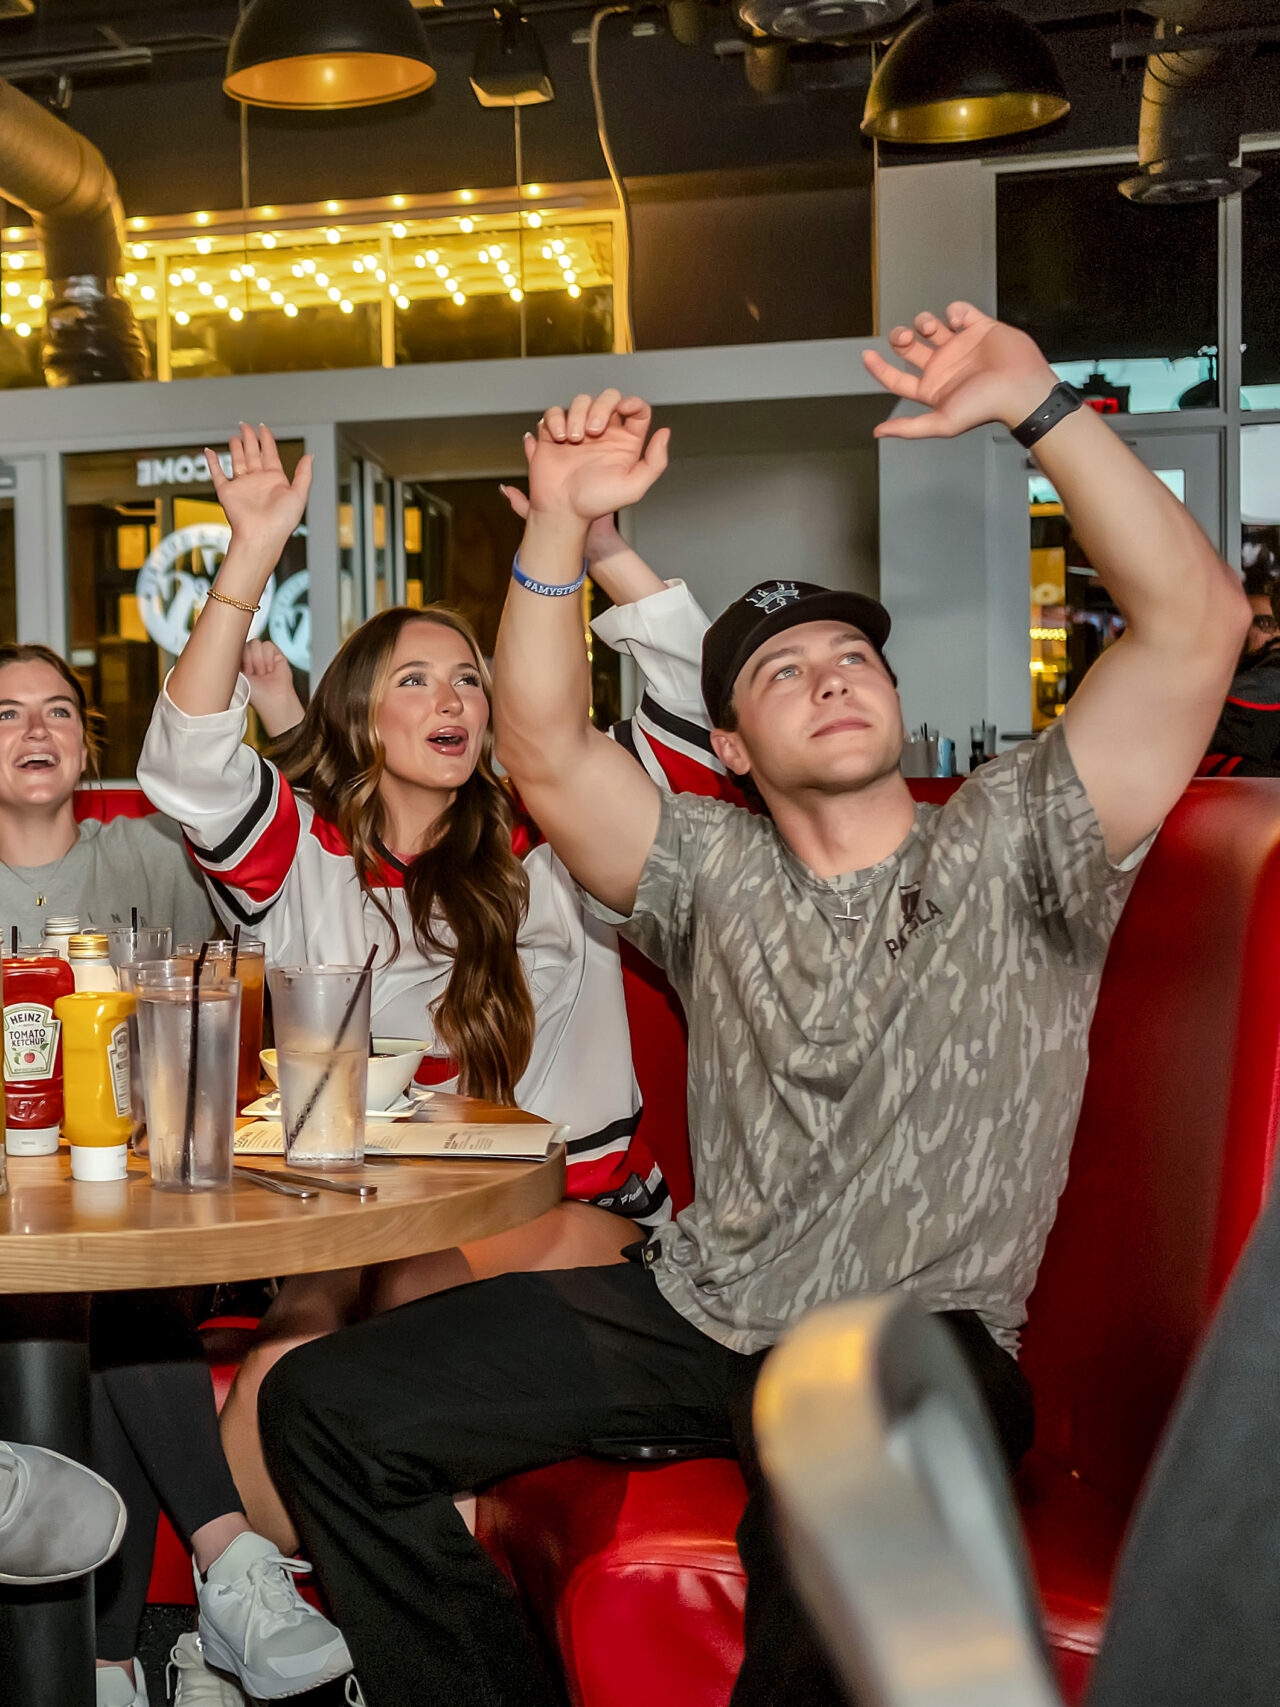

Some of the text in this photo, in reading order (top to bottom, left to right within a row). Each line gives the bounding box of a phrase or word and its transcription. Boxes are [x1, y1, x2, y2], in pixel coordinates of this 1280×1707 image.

[10, 1012, 42, 1025] HEINZ
[9, 1028, 46, 1040] TOMATO
[11, 1037, 46, 1047] KETCHUP
